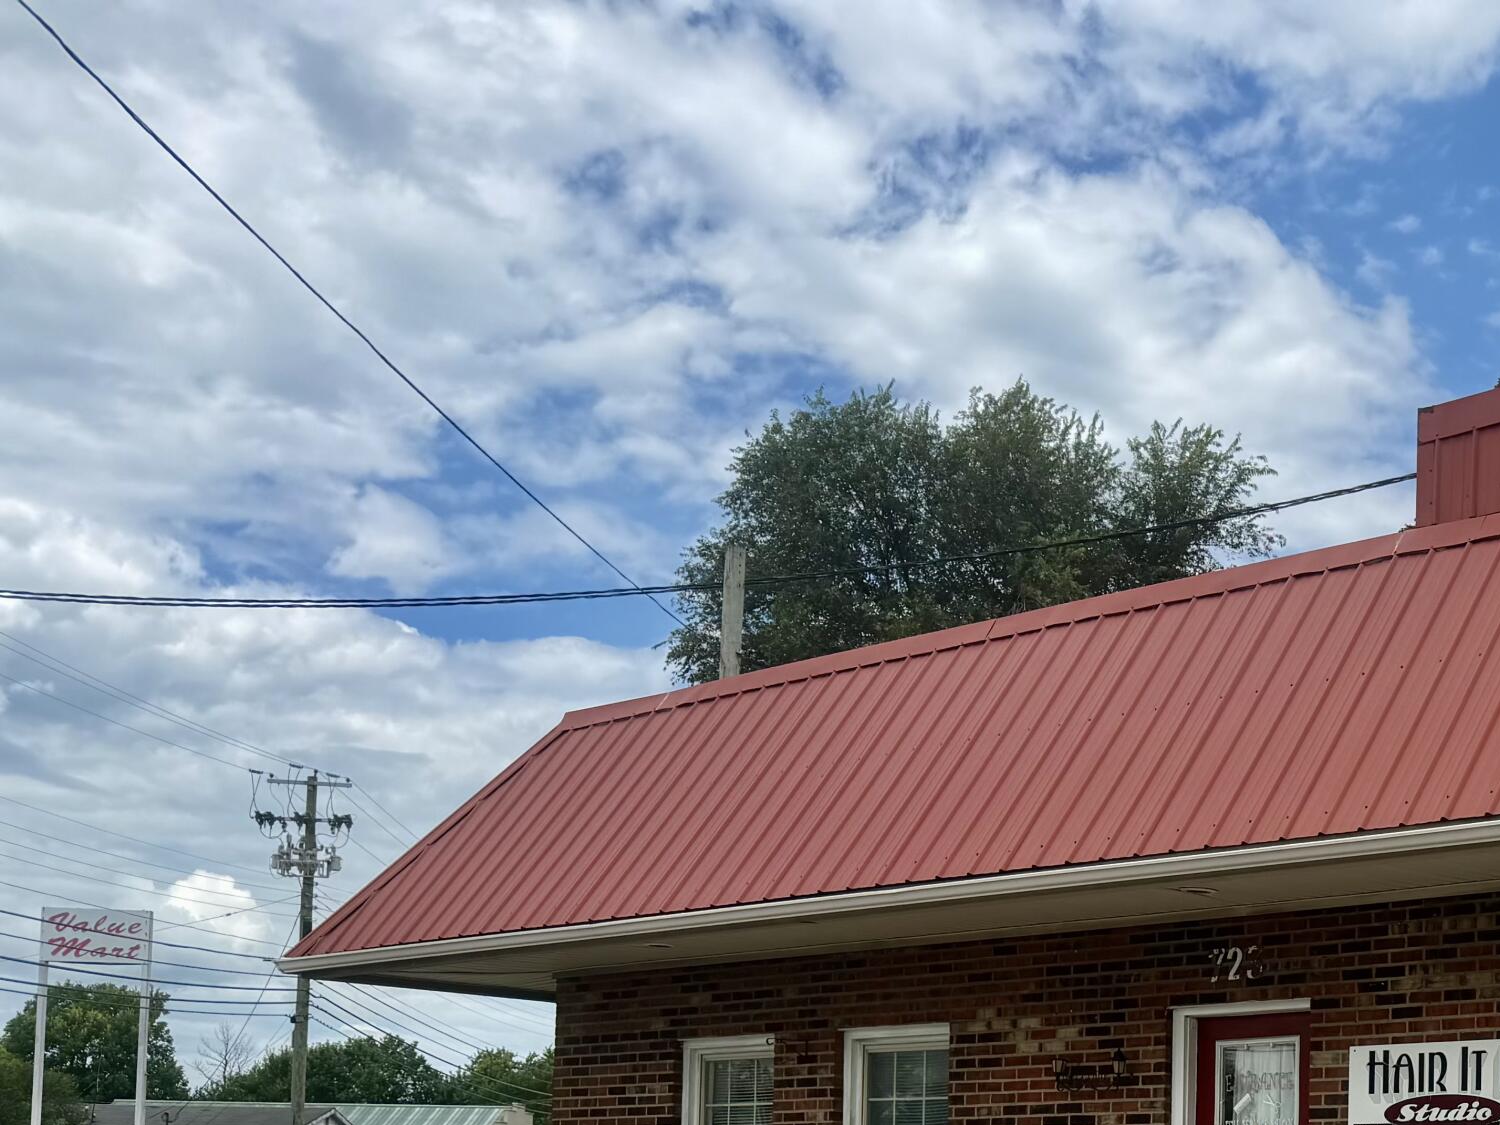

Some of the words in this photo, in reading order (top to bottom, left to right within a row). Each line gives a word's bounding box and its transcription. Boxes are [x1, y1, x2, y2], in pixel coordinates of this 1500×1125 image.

[48, 912, 143, 933] Value
[47, 937, 141, 957] Mart
[1367, 1050, 1448, 1094] HAIR
[1397, 1101, 1492, 1122] Studio
